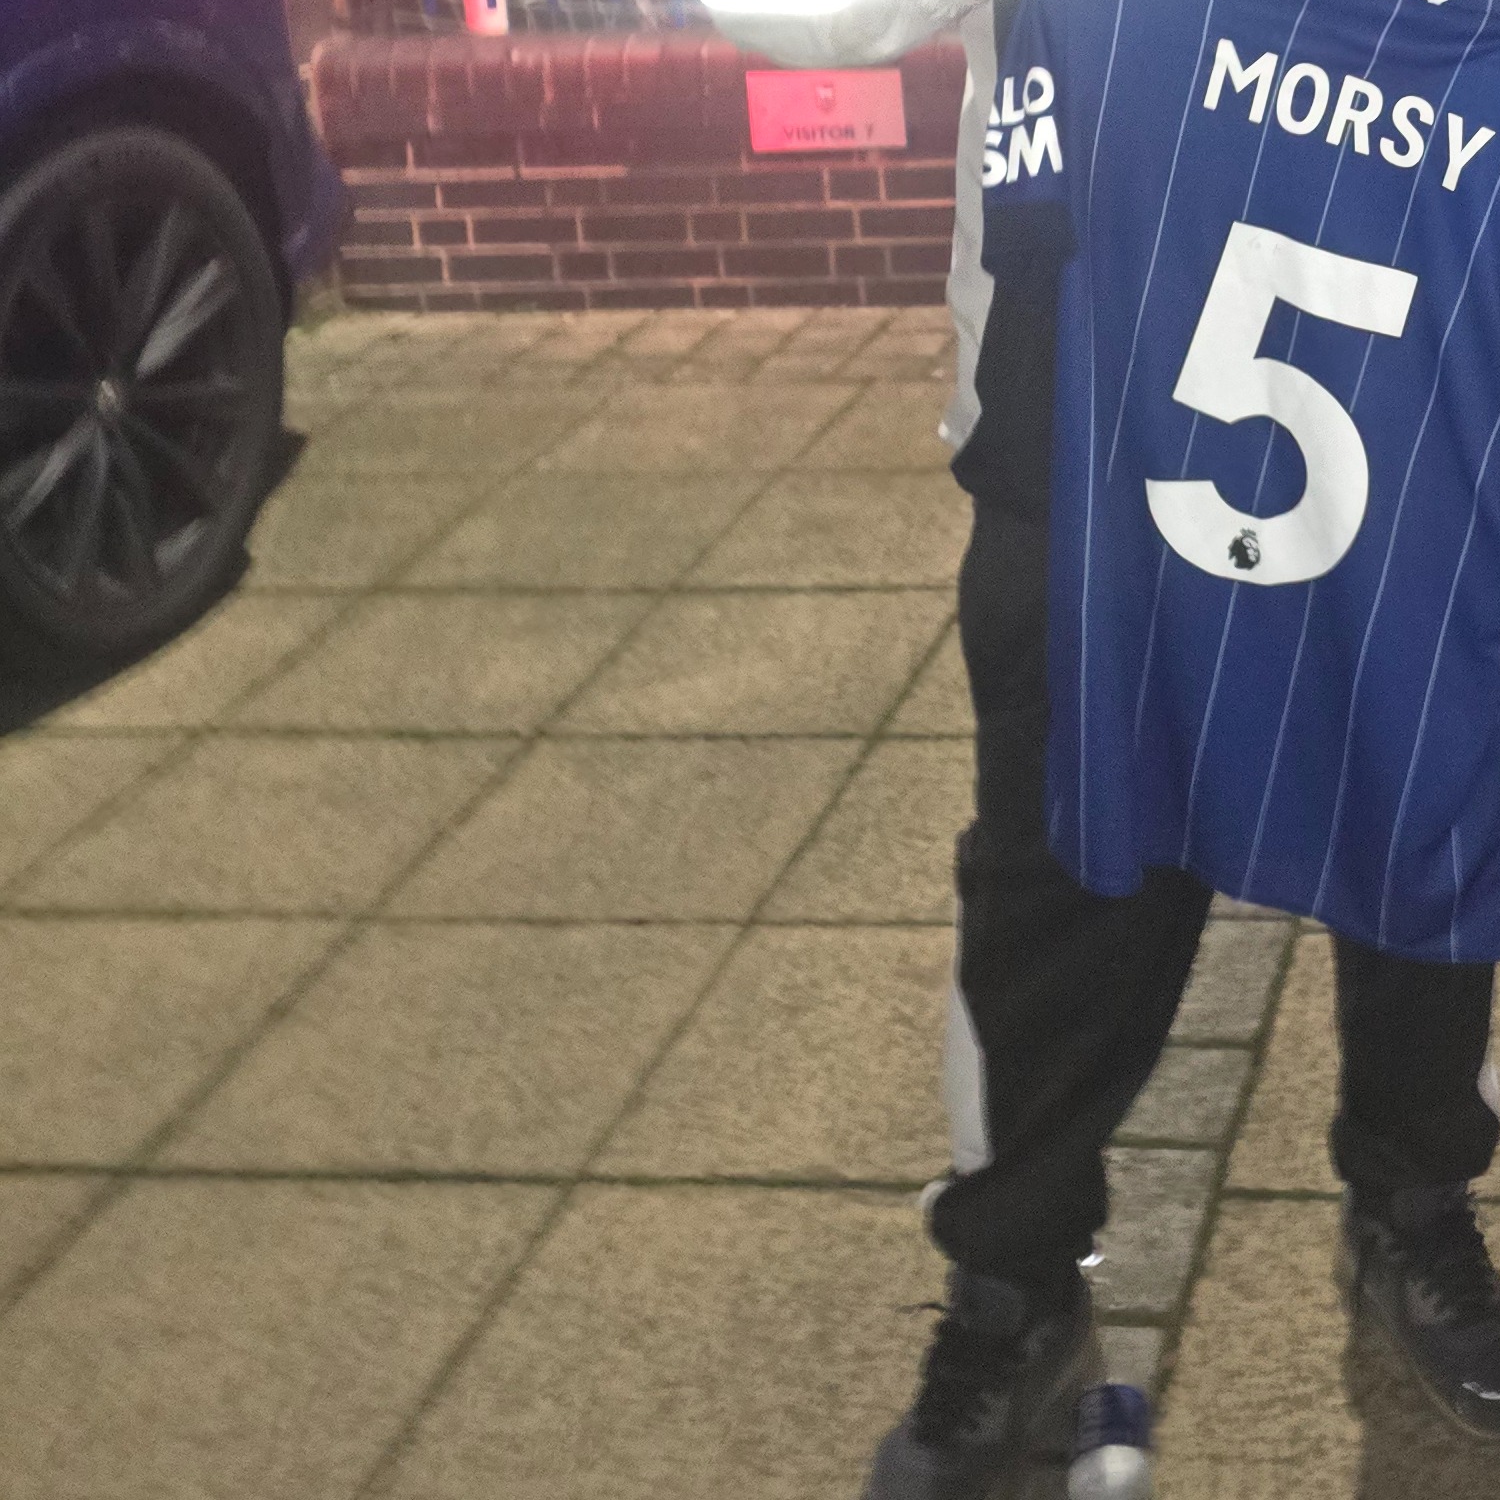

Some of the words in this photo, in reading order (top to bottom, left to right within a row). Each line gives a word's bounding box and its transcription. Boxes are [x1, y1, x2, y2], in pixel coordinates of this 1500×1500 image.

[782, 124, 856, 141] VISITOR
[1203, 38, 1496, 191] MORSY
[1145, 220, 1418, 585] 5
